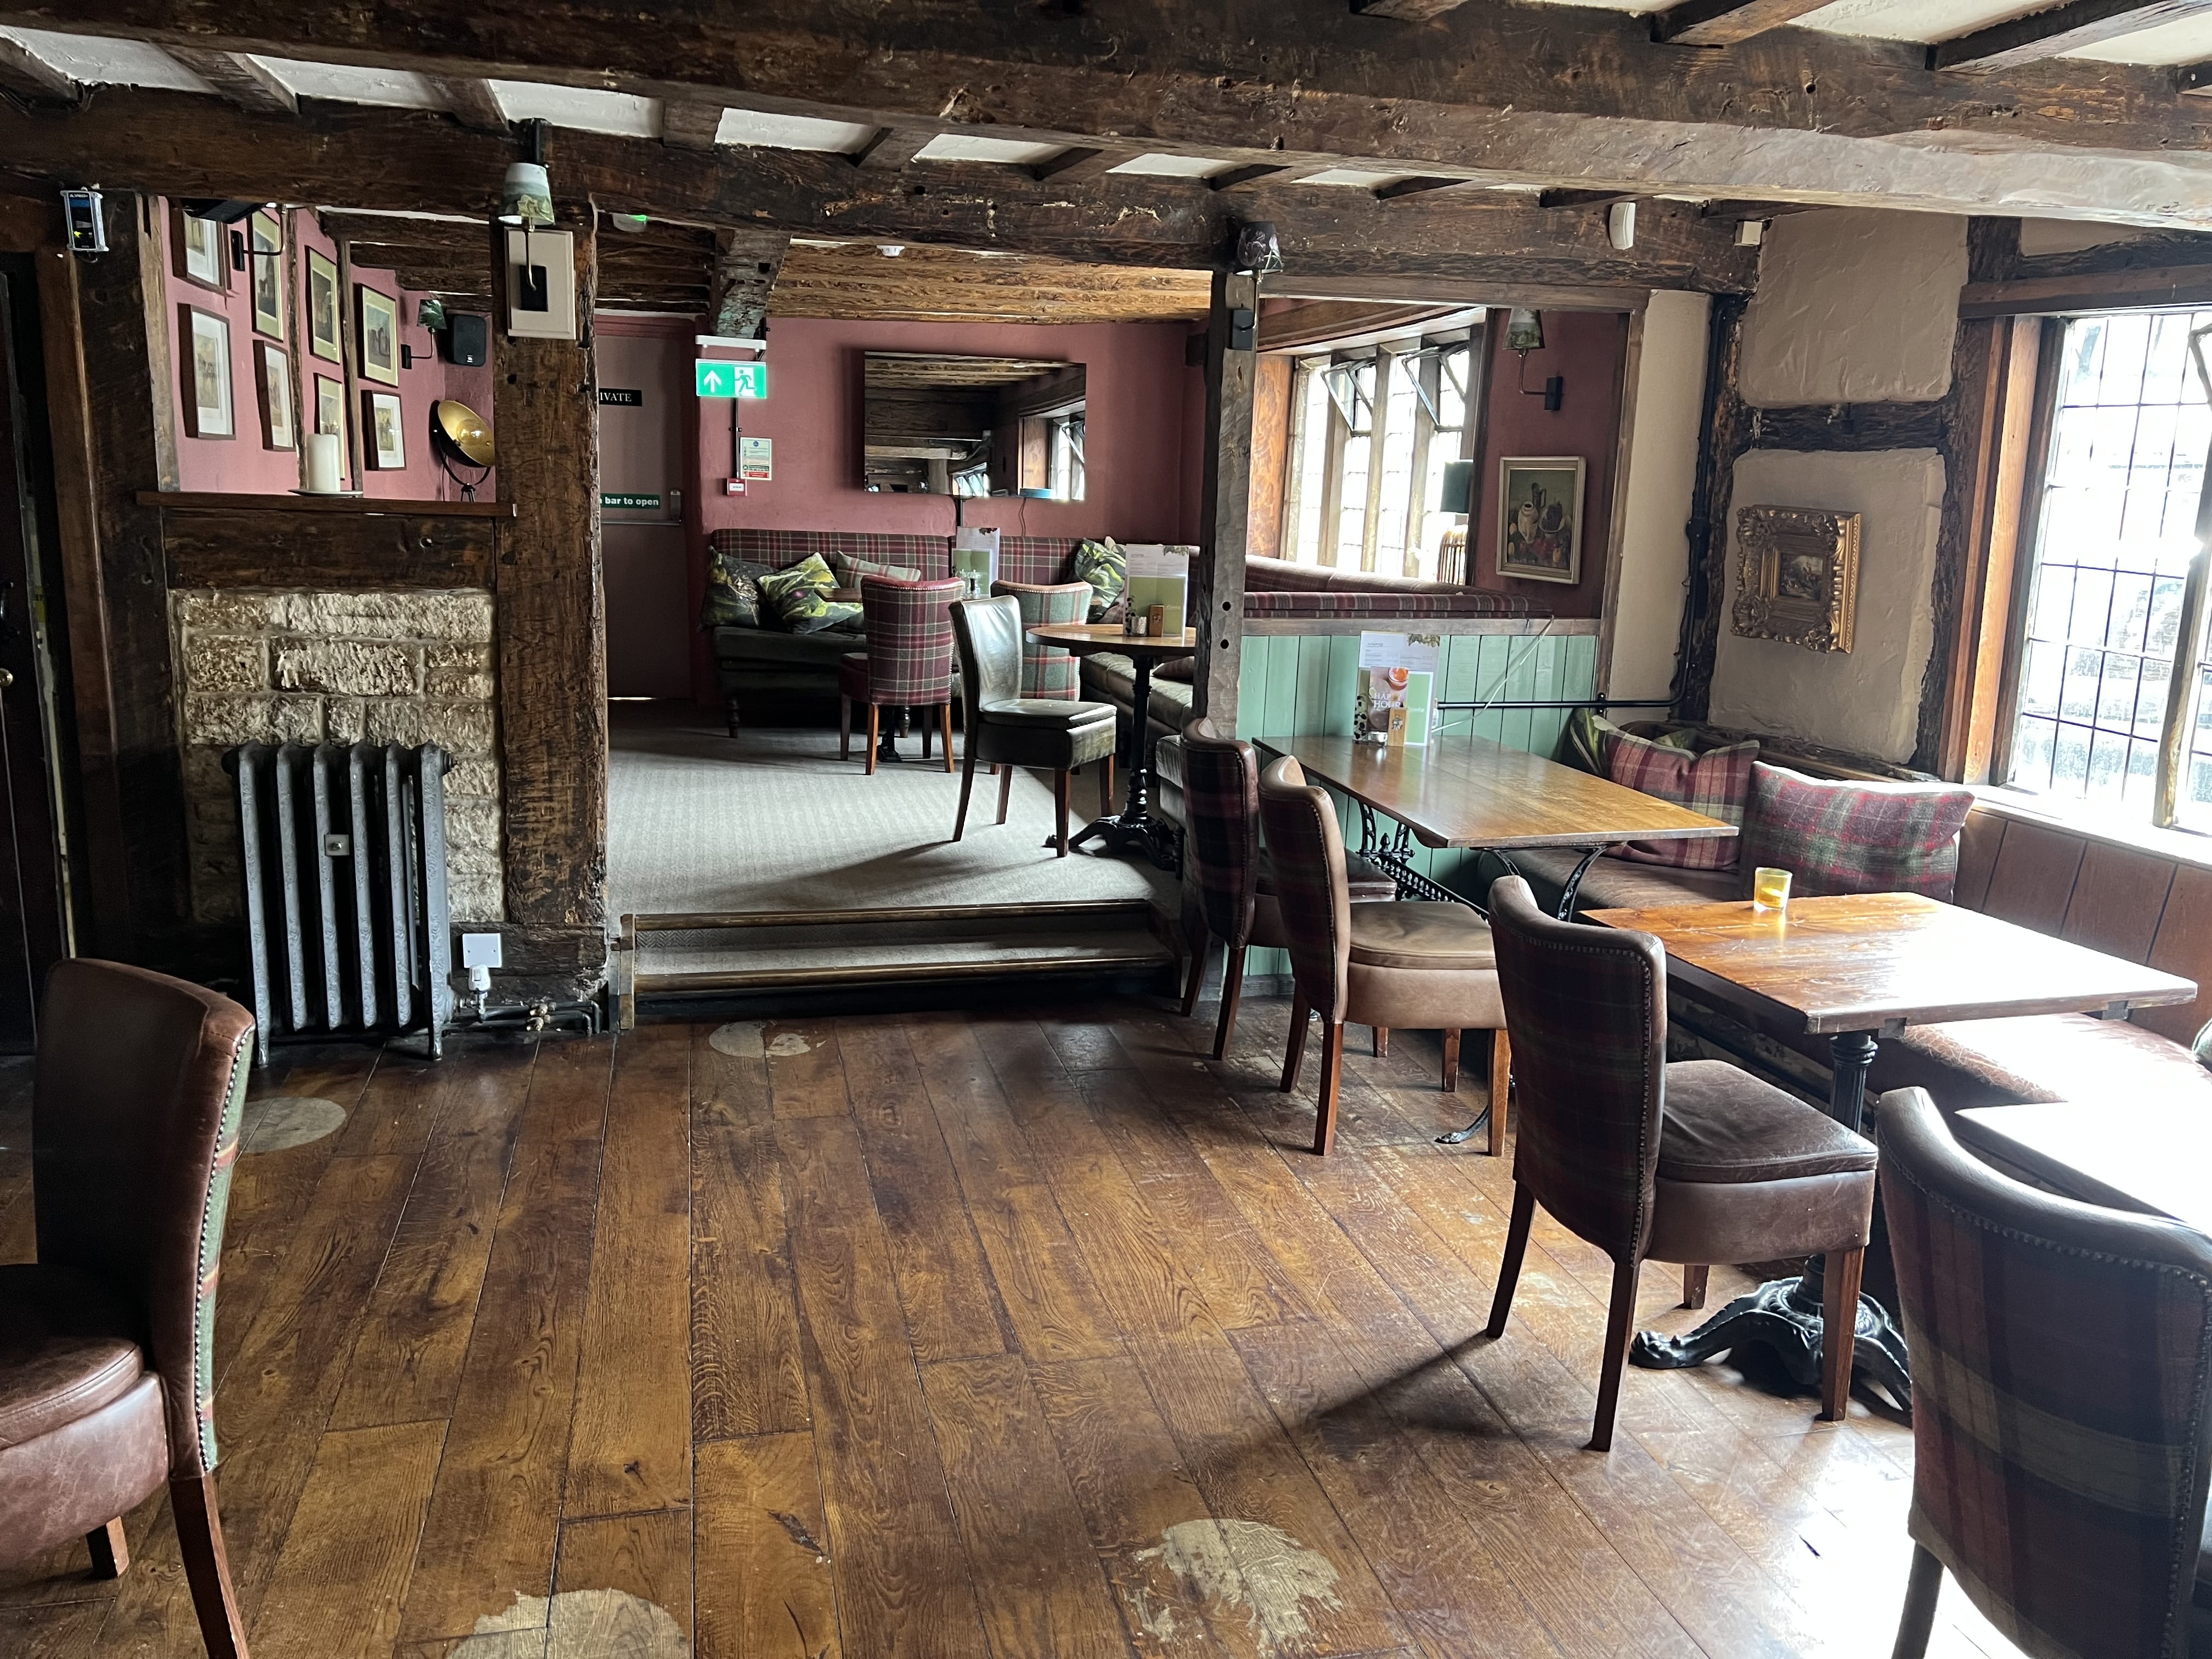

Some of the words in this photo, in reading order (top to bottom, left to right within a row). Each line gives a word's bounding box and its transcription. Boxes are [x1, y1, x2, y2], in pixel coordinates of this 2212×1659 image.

[600, 392, 632, 402] IVATE
[635, 499, 659, 507] open
[1373, 700, 1401, 708] HOUR
